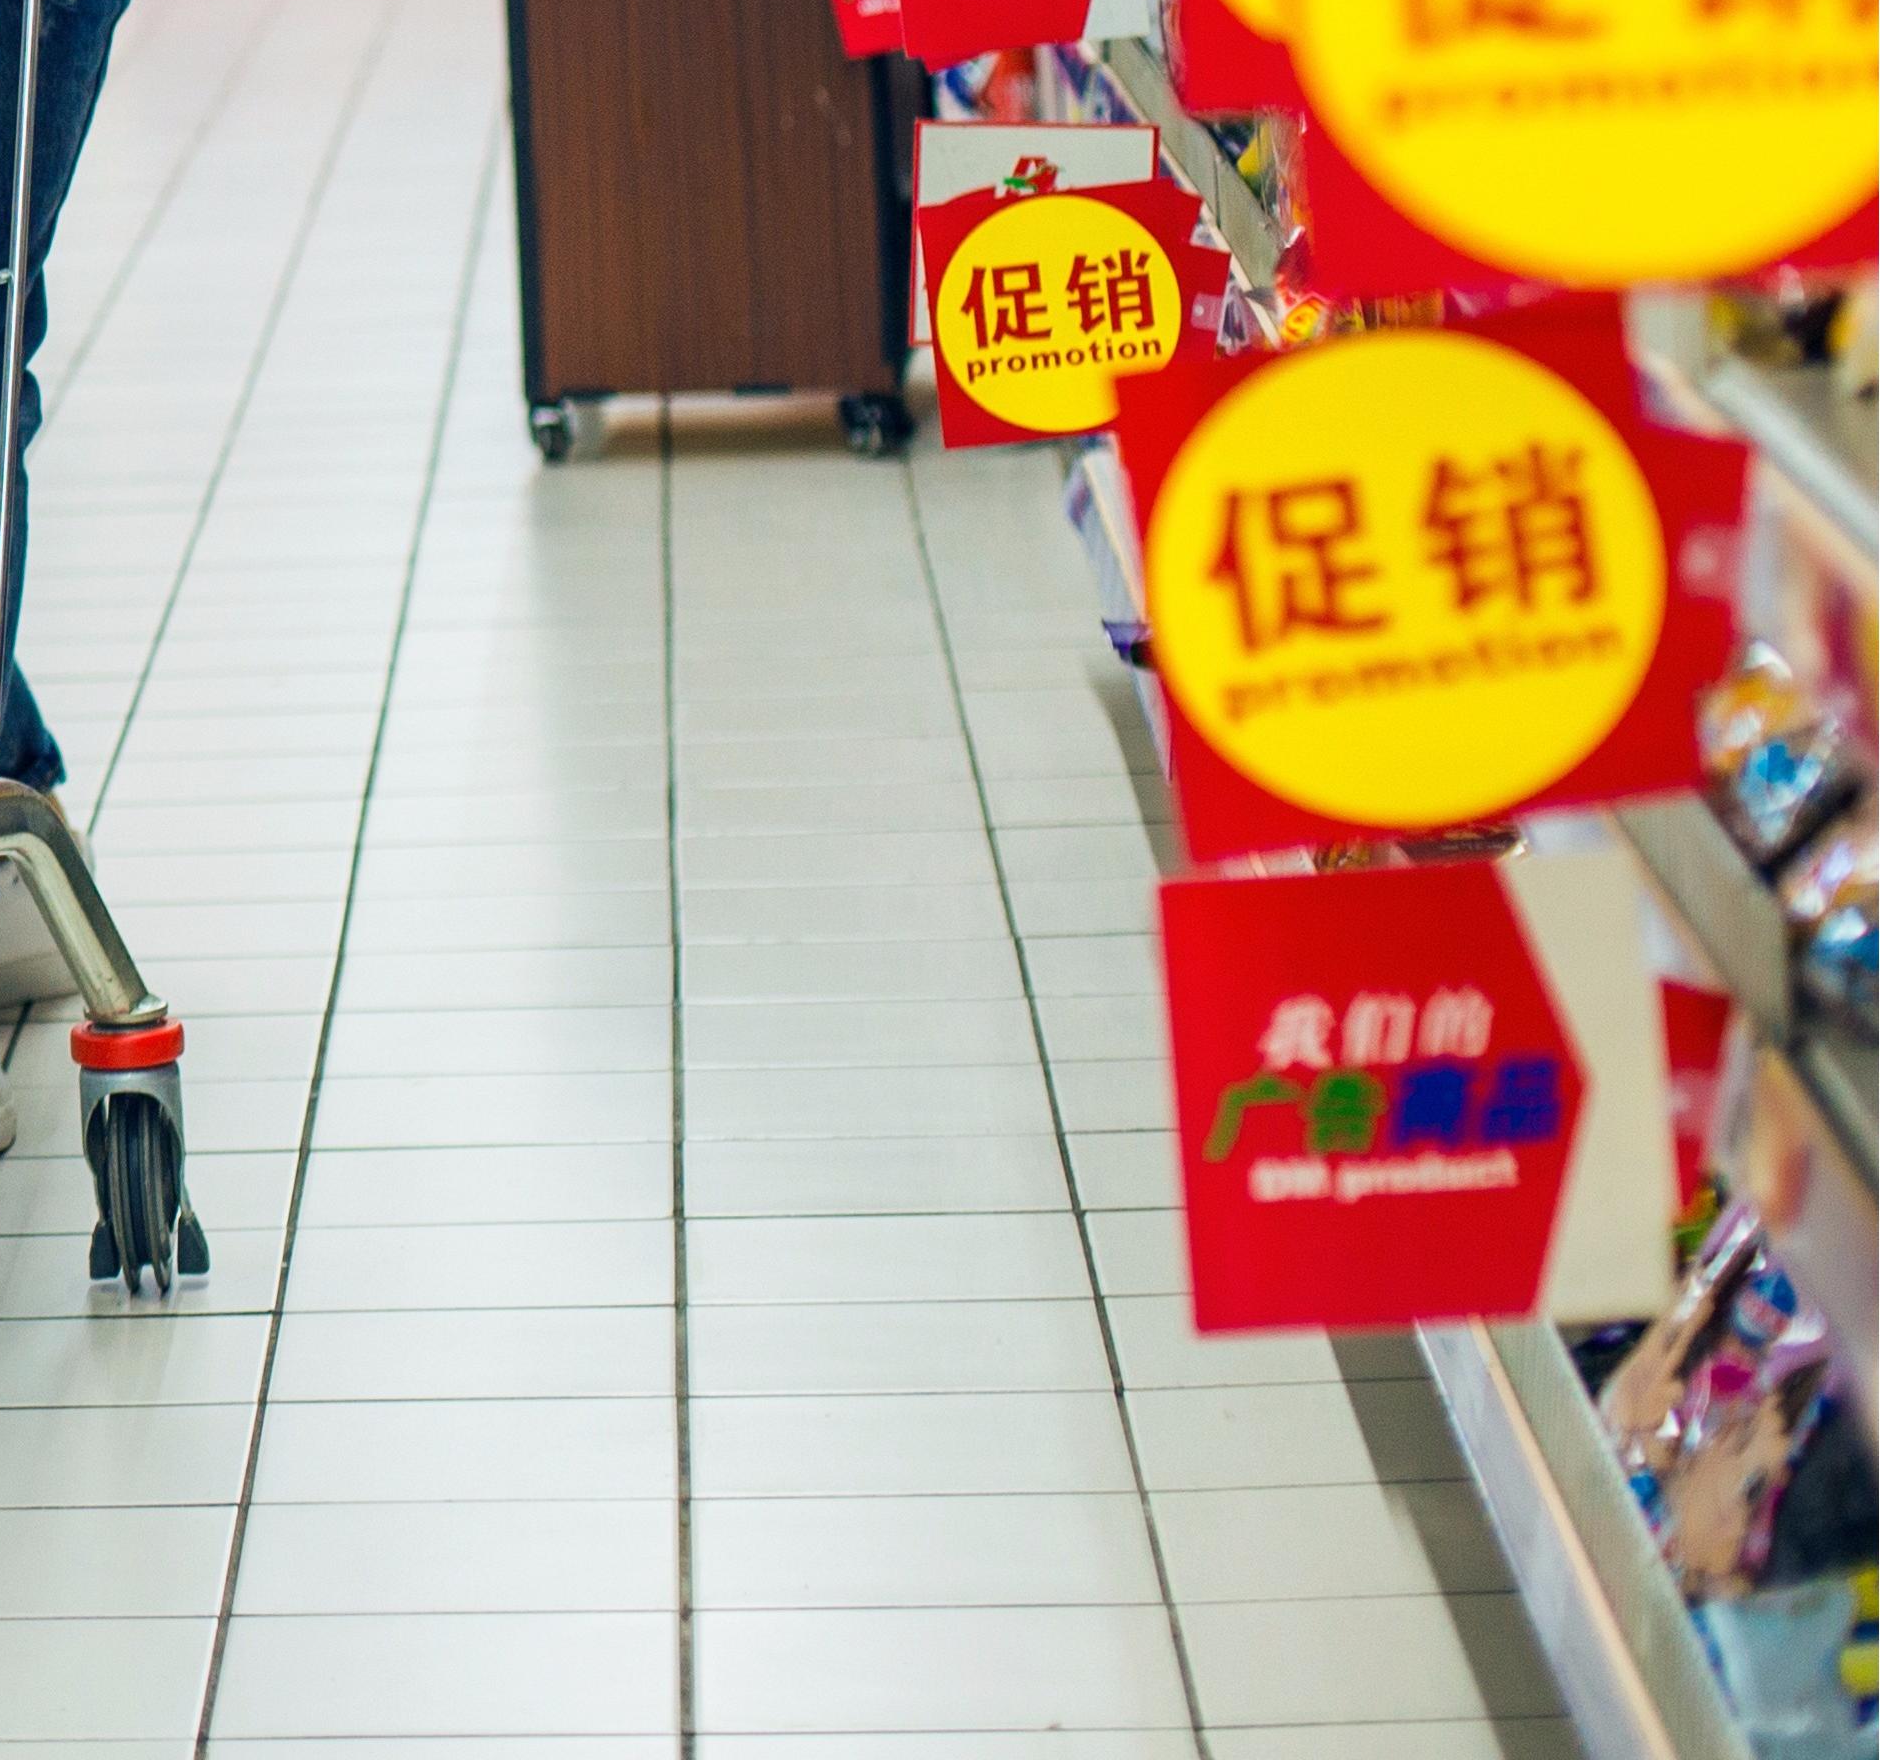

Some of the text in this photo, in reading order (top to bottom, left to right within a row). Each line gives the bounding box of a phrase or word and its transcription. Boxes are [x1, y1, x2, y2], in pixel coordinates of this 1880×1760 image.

[959, 248, 1155, 350] 促销
[966, 336, 1163, 384] promotion
[1203, 442, 1607, 666] 促销
[1219, 623, 1625, 723] promotion
[1259, 986, 1496, 1072] 我们的
[1203, 1057, 1561, 1162] 广告商品
[1251, 1151, 1519, 1203] DM product
